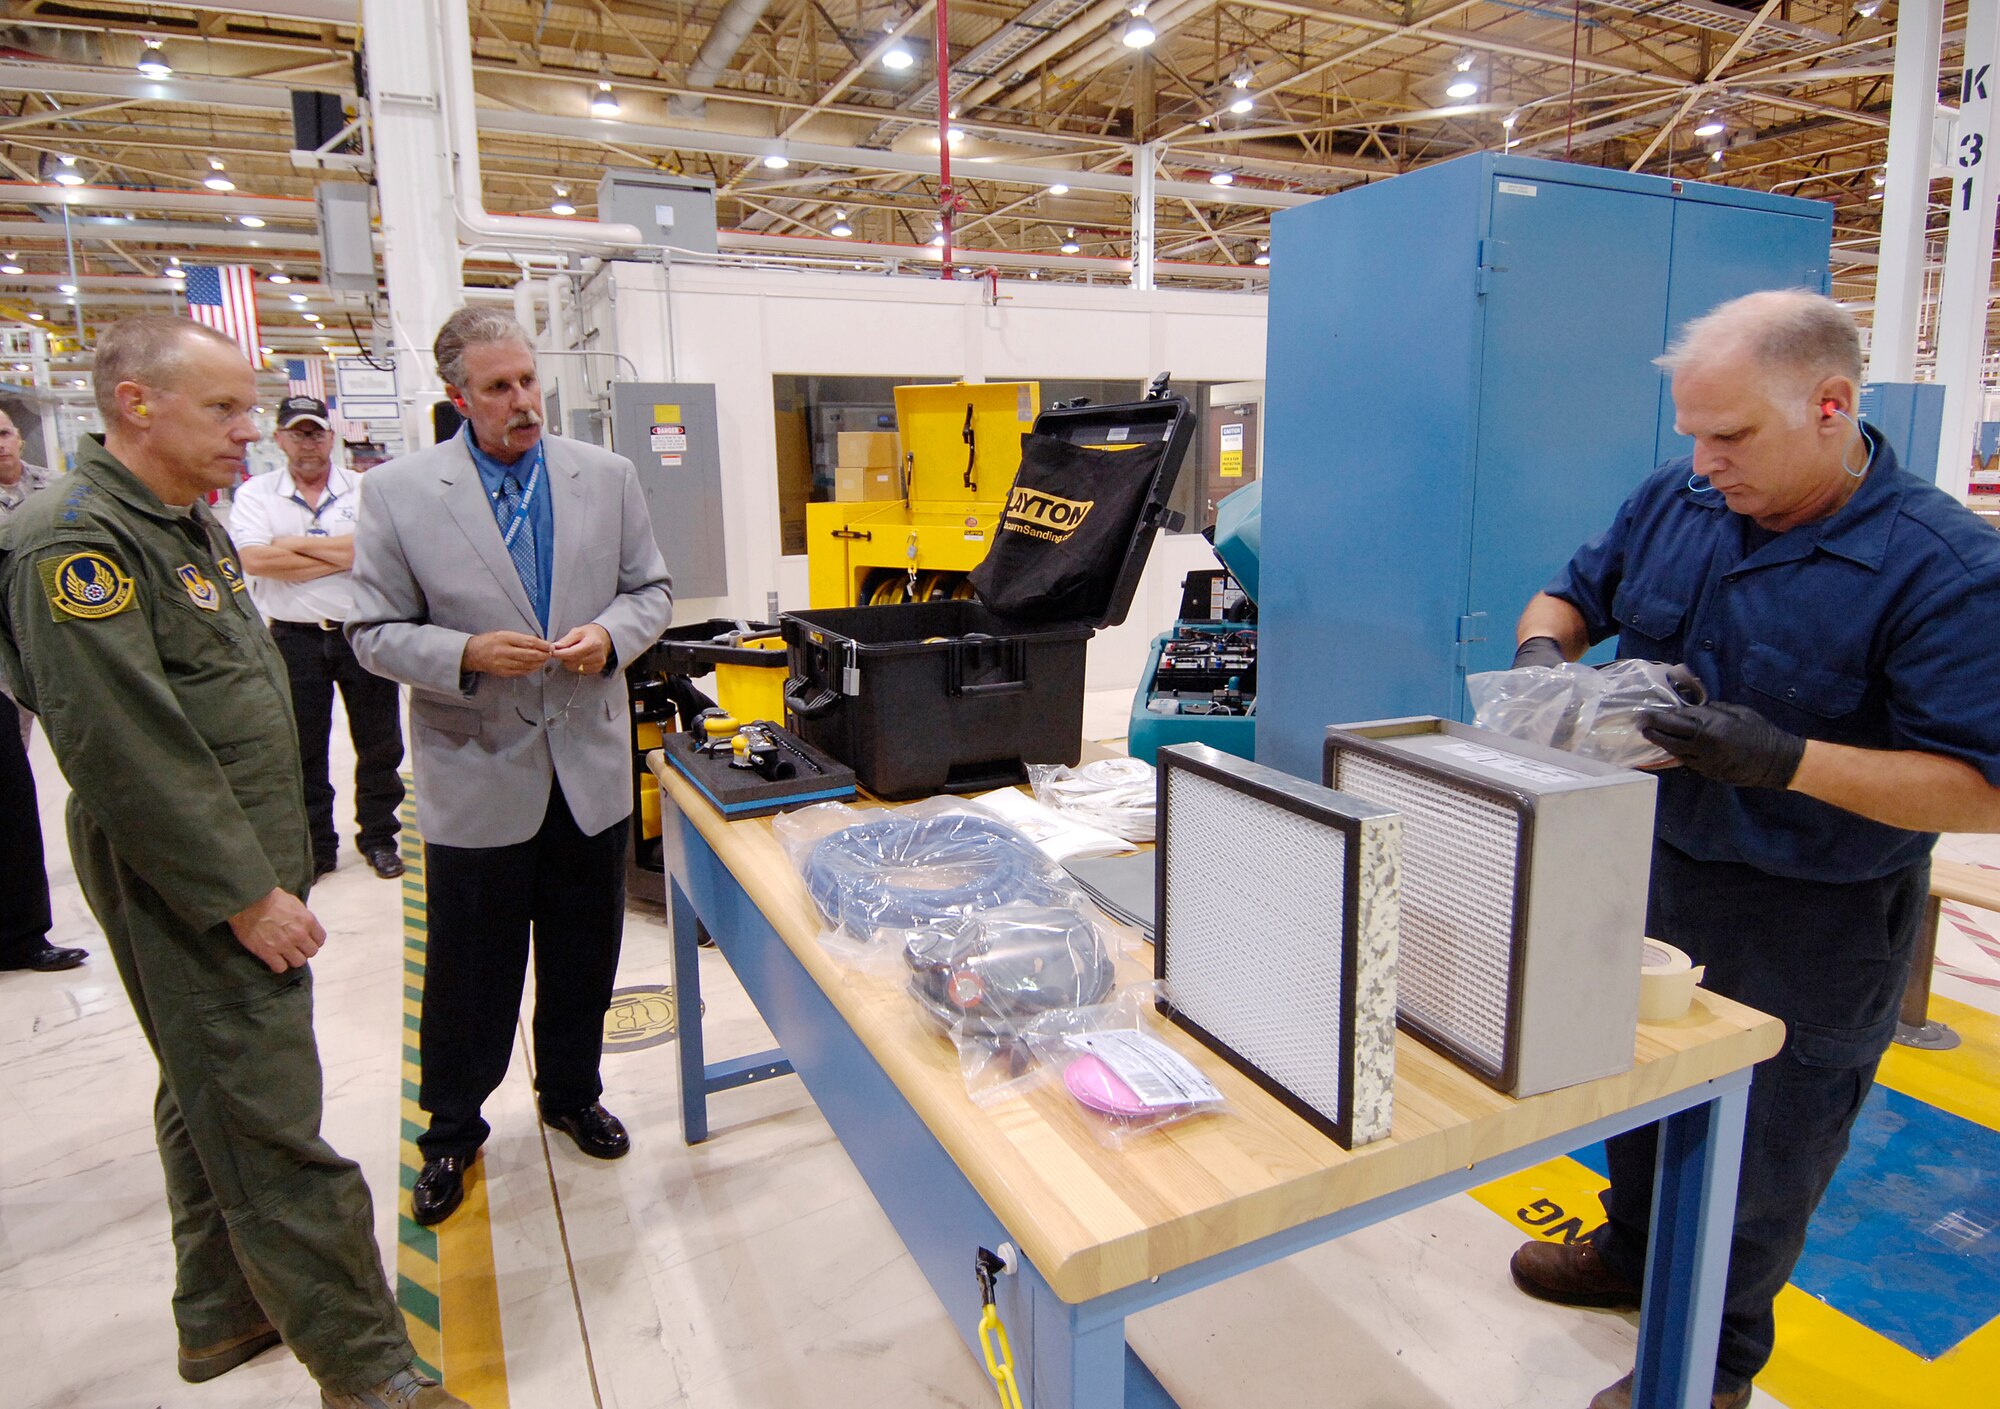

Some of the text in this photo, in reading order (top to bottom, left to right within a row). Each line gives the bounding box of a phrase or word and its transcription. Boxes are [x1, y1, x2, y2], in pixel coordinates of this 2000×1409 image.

[1962, 64, 1991, 104] K
[1133, 196, 1140, 214] K
[66, 600, 118, 615] HEADQUARTERS
